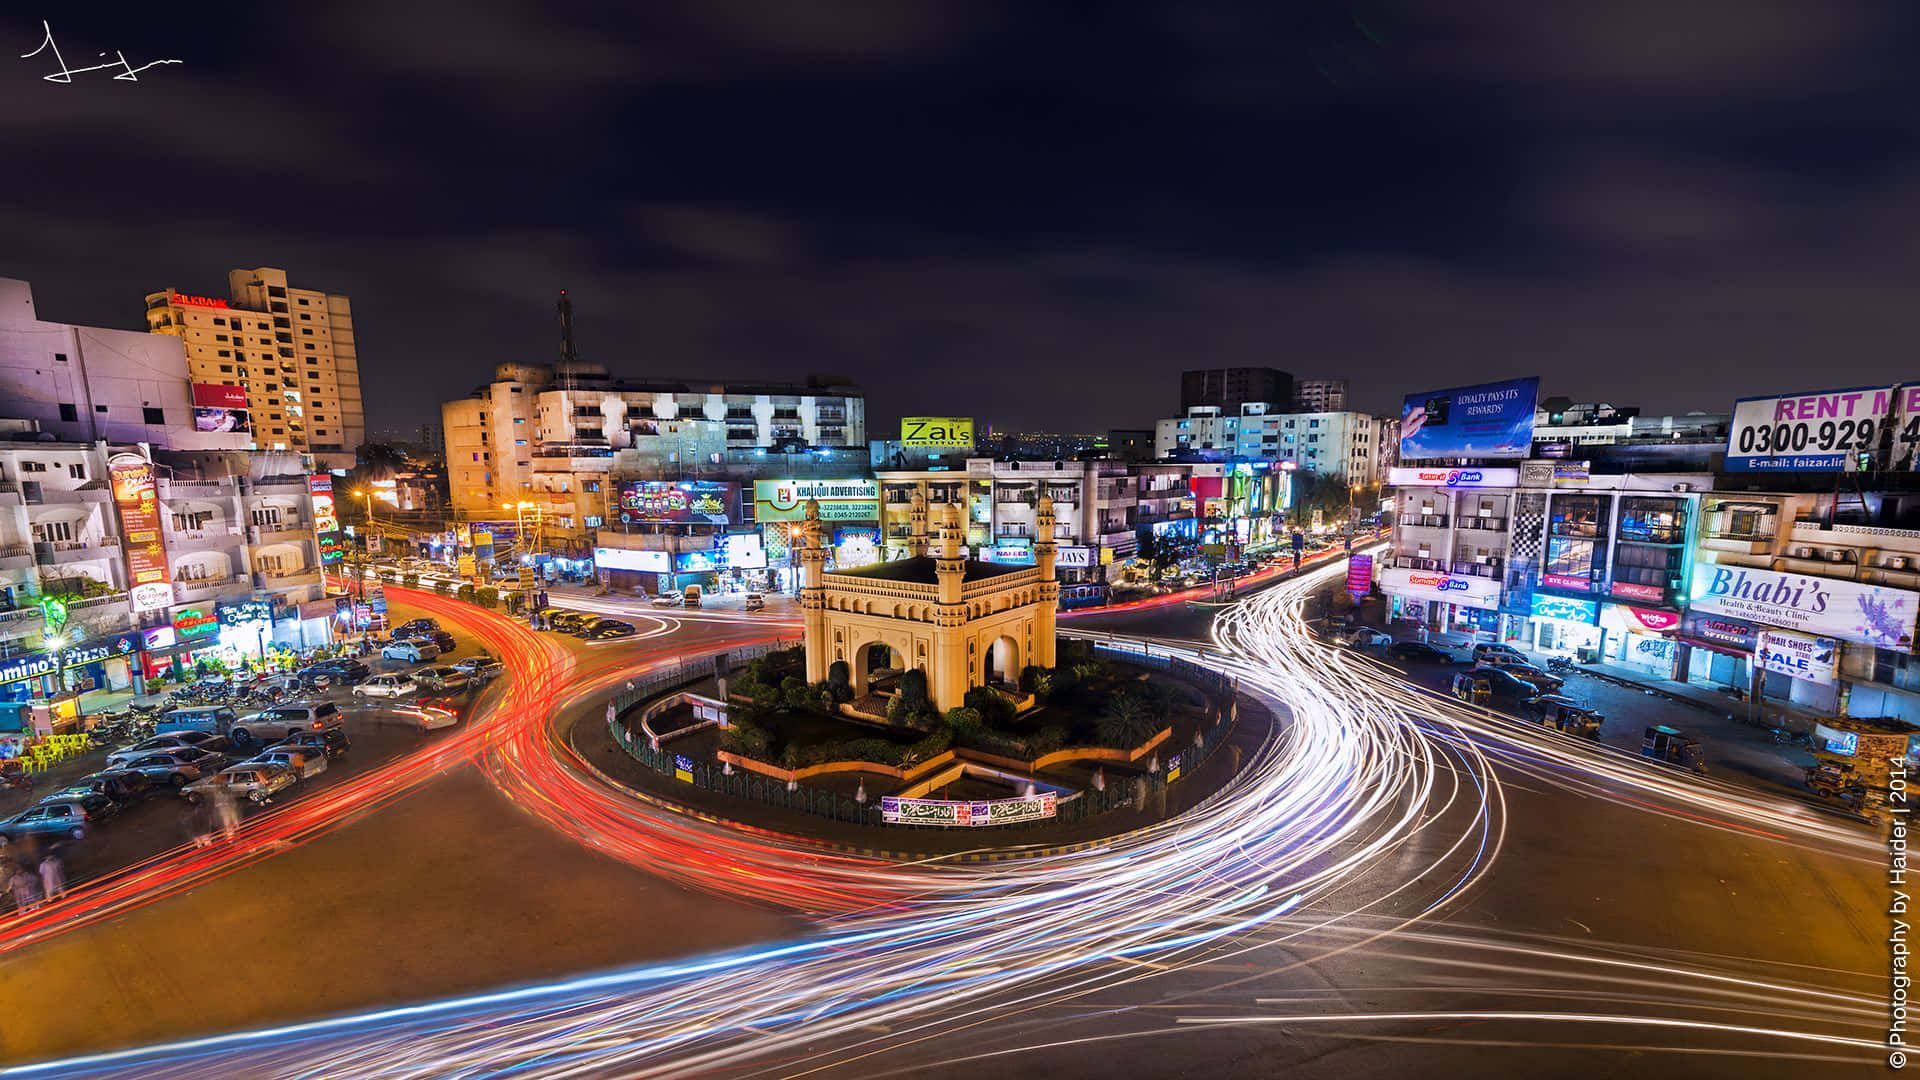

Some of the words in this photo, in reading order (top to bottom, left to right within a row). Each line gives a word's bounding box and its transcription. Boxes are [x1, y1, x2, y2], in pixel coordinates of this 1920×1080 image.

[1458, 393, 1487, 405] LOYALTY
[1487, 390, 1505, 402] PAYS
[1774, 393, 1863, 421] RENT
[1749, 458, 1790, 469] E-mail:
[1460, 471, 1483, 482] Bank
[797, 486, 829, 498] KHAIQUI
[830, 486, 876, 497] ADVERTISING
[1449, 579, 1469, 590] Bank
[1709, 566, 1831, 613] Bhabi's
[1719, 598, 1744, 610] Health
[1755, 604, 1782, 617] Beauty
[1785, 609, 1810, 622] Clinic
[1787, 639, 1813, 653] SHOES
[0, 653, 60, 680] mino's
[63, 646, 110, 666] Pizza
[1759, 649, 1809, 671] SALE
